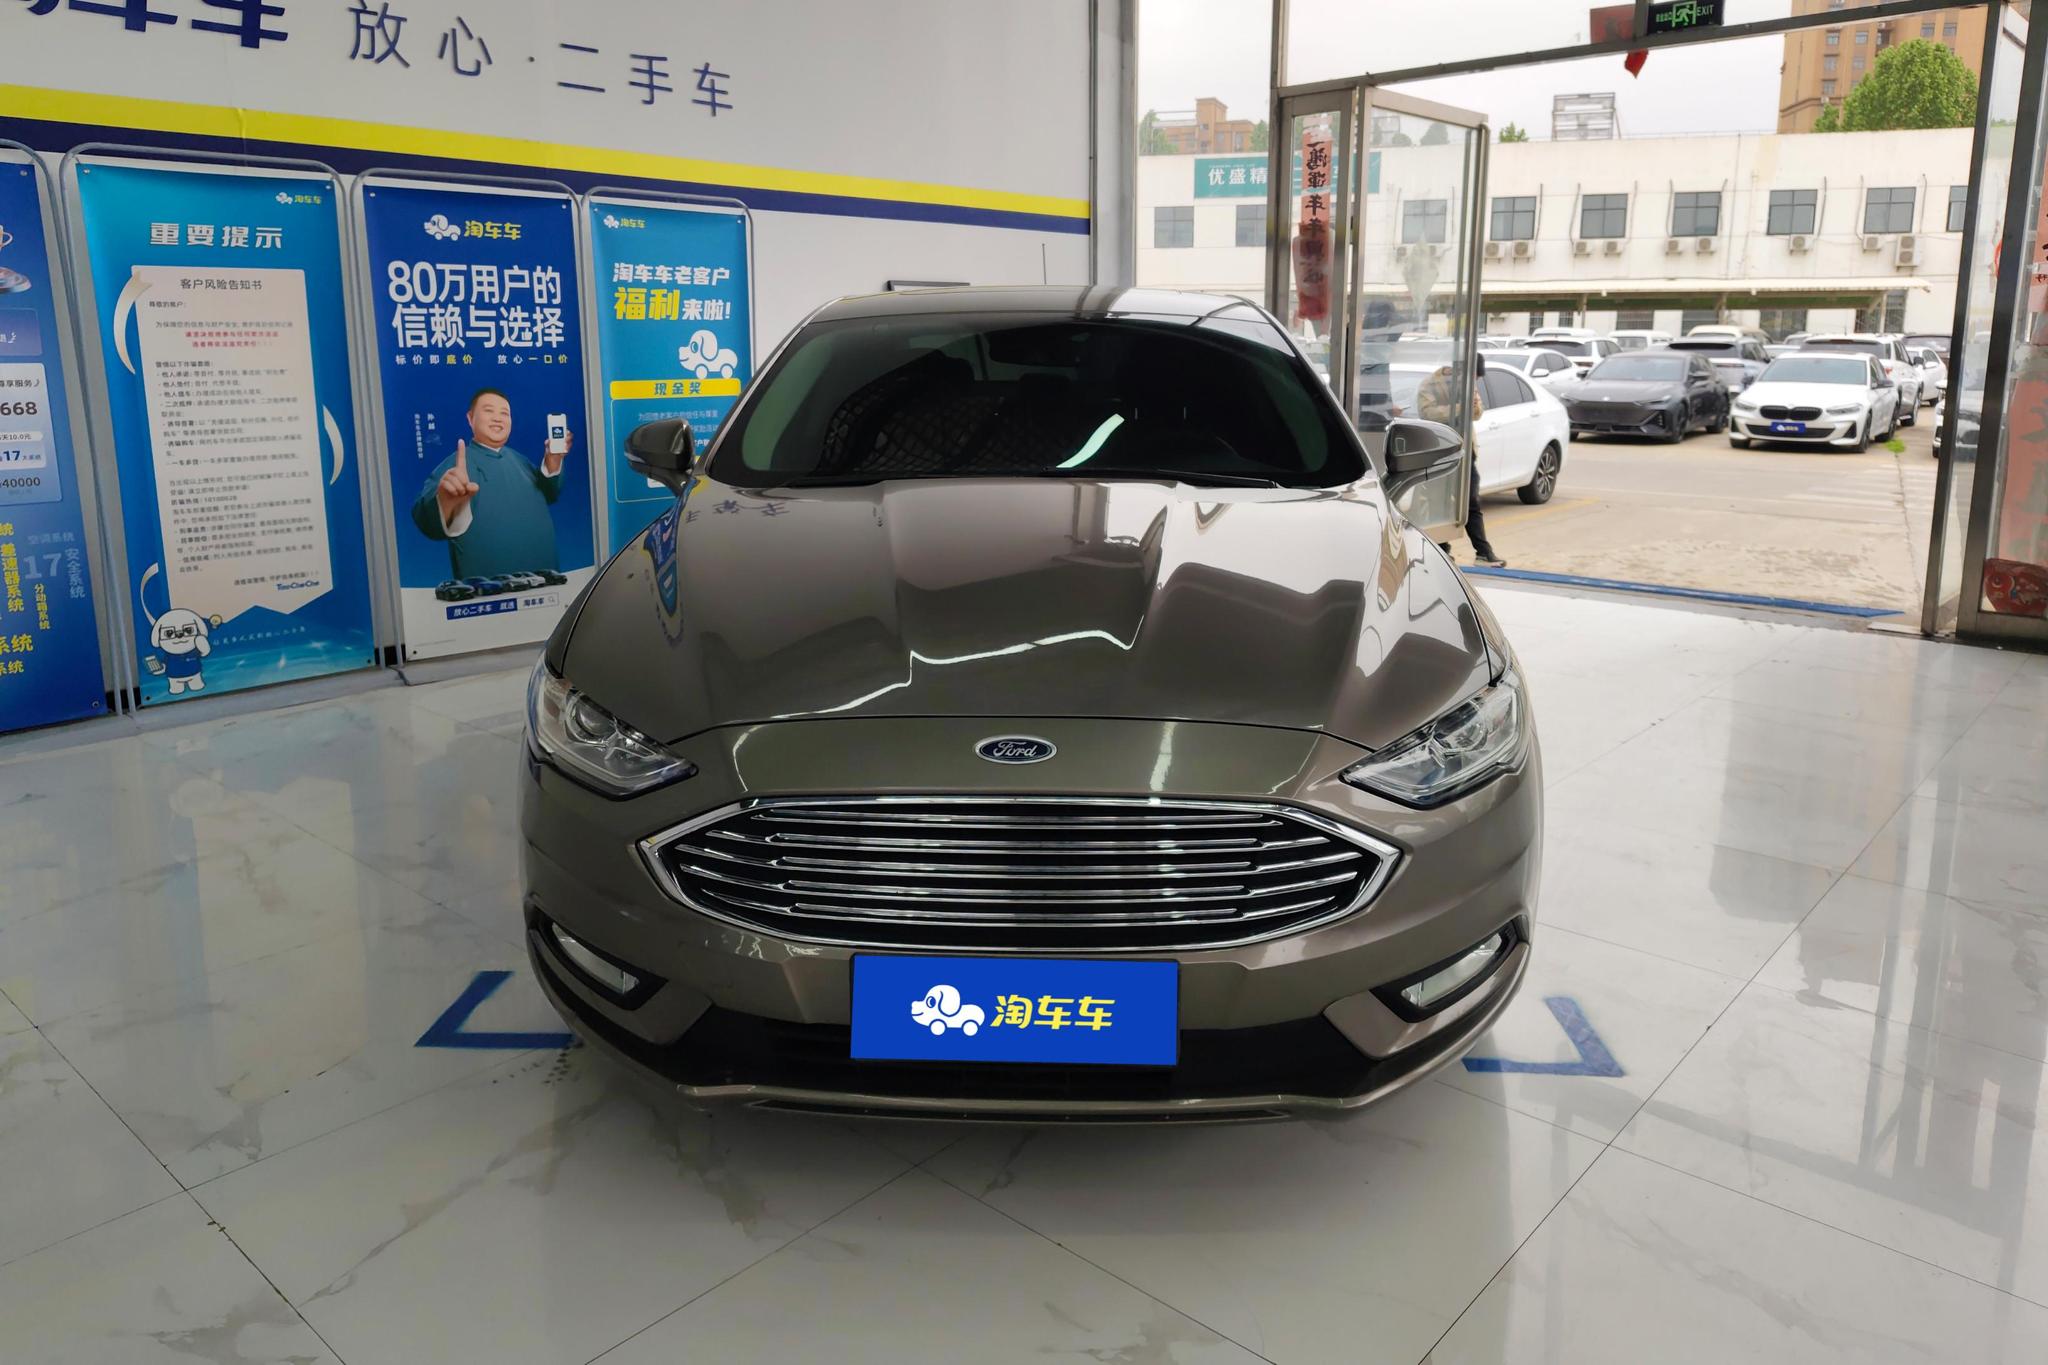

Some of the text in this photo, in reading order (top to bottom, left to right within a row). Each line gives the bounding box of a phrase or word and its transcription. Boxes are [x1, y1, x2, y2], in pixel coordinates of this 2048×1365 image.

[1697, 5, 1715, 17] EXIT
[150, 222, 284, 249] 重要提示
[463, 220, 522, 241] 淘车车
[180, 278, 263, 291] 客户风险告知书
[387, 260, 562, 305] 80万用户的
[612, 262, 730, 286] 淘车车老客户
[391, 303, 566, 349] 信赖与选择
[394, 354, 568, 366] 标价即底价 放心一口价
[653, 382, 702, 396] 现金奖
[65, 547, 87, 599] 安全系统
[992, 740, 1038, 758] Ford
[990, 994, 1116, 1031] 淘车车
